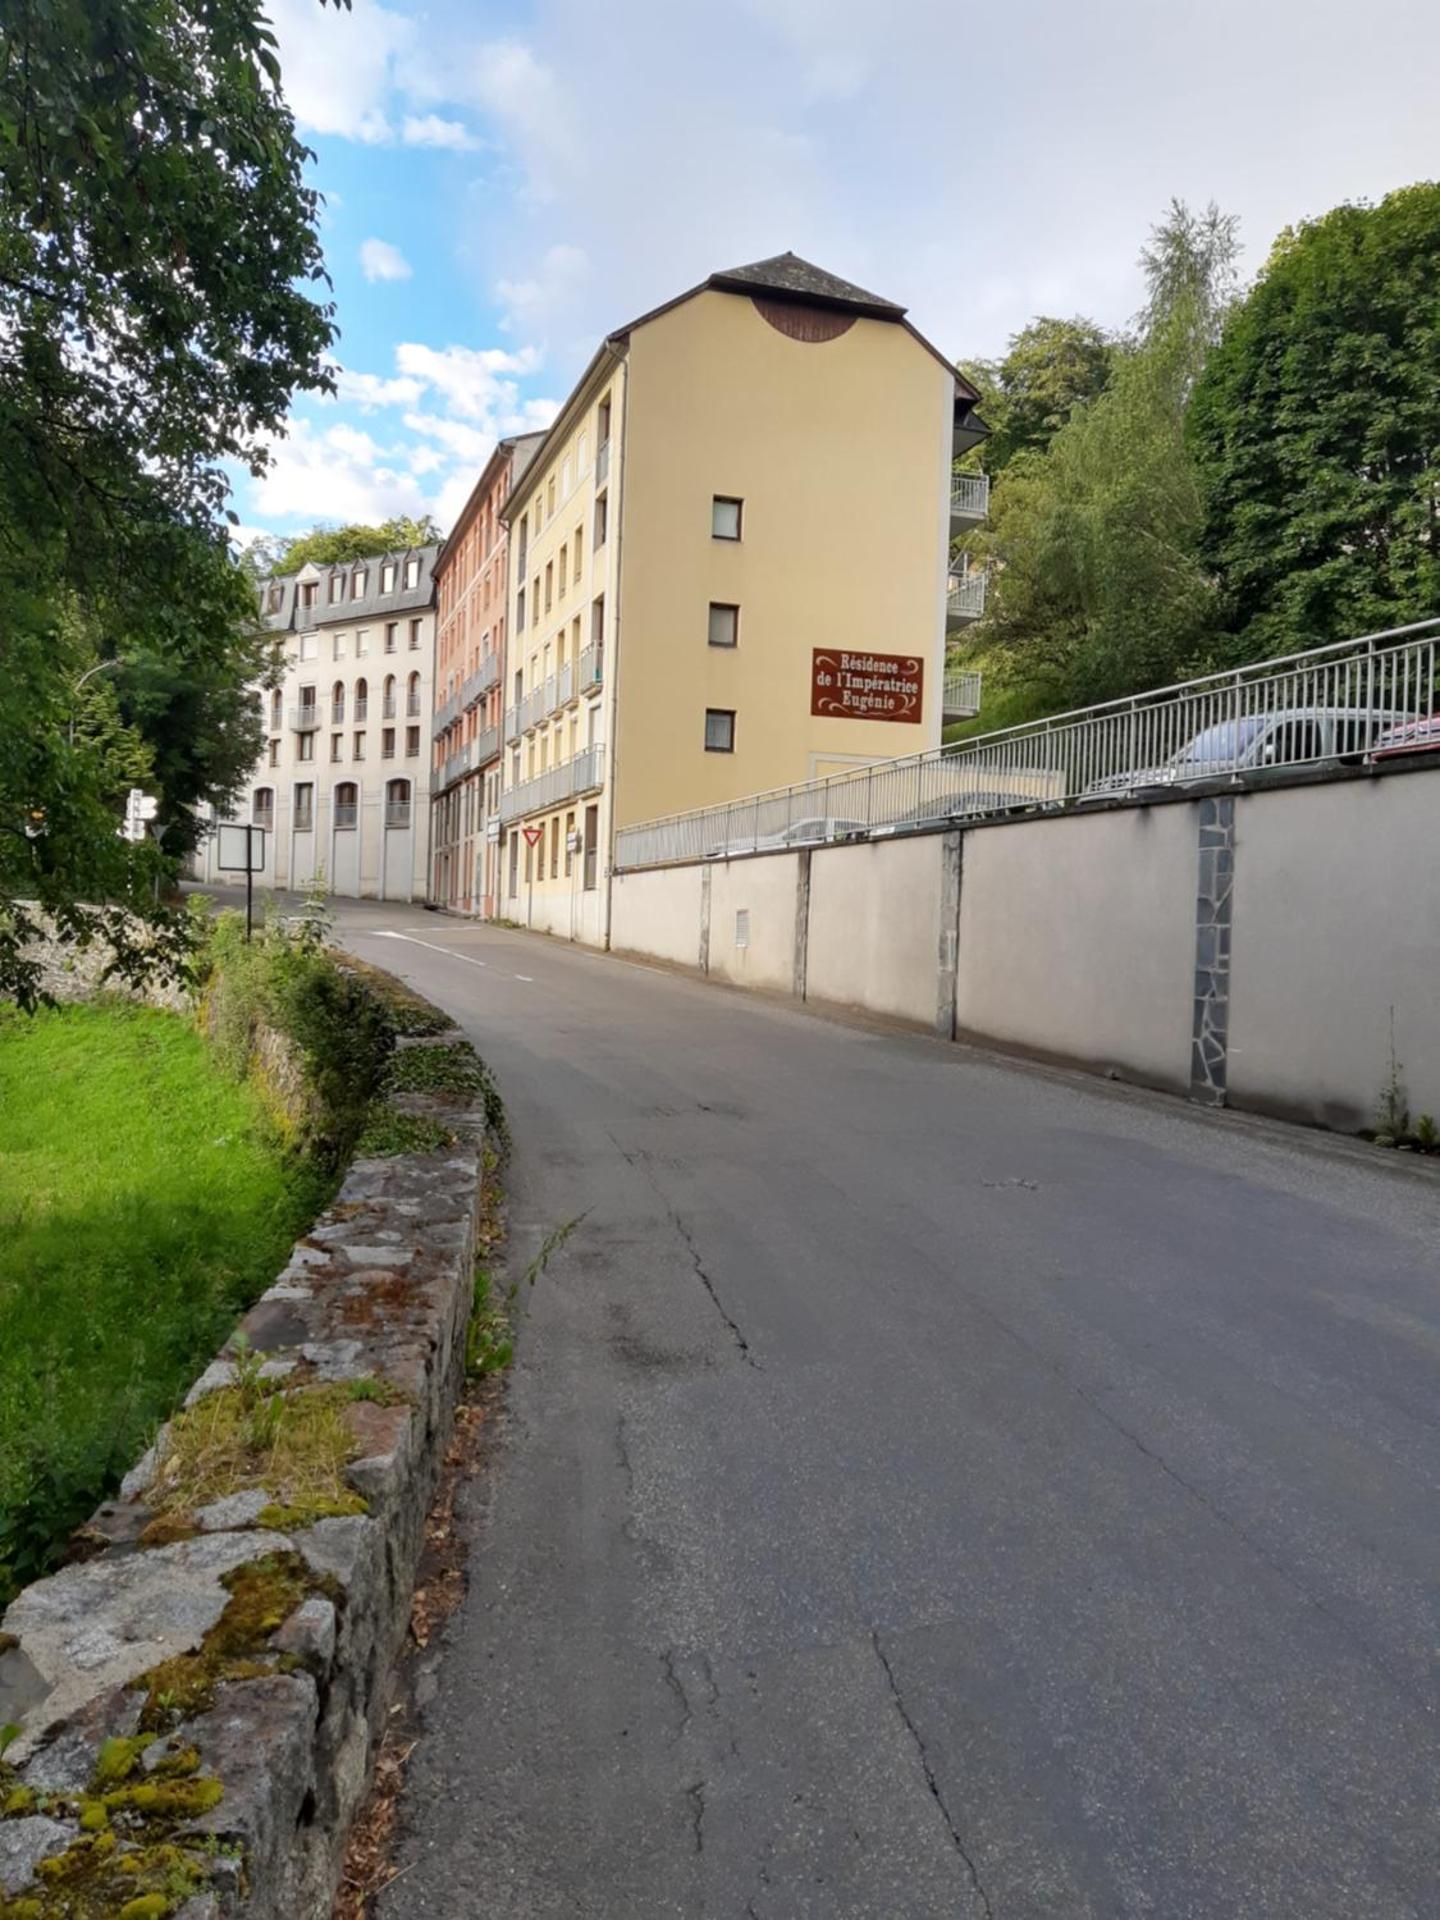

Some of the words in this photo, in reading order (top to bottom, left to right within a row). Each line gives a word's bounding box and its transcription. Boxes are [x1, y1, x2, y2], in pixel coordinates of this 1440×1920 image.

[841, 654, 898, 674] Résidence
[817, 671, 831, 686] de
[837, 672, 918, 693] l'Impératrice
[842, 690, 895, 711] Eugénie
